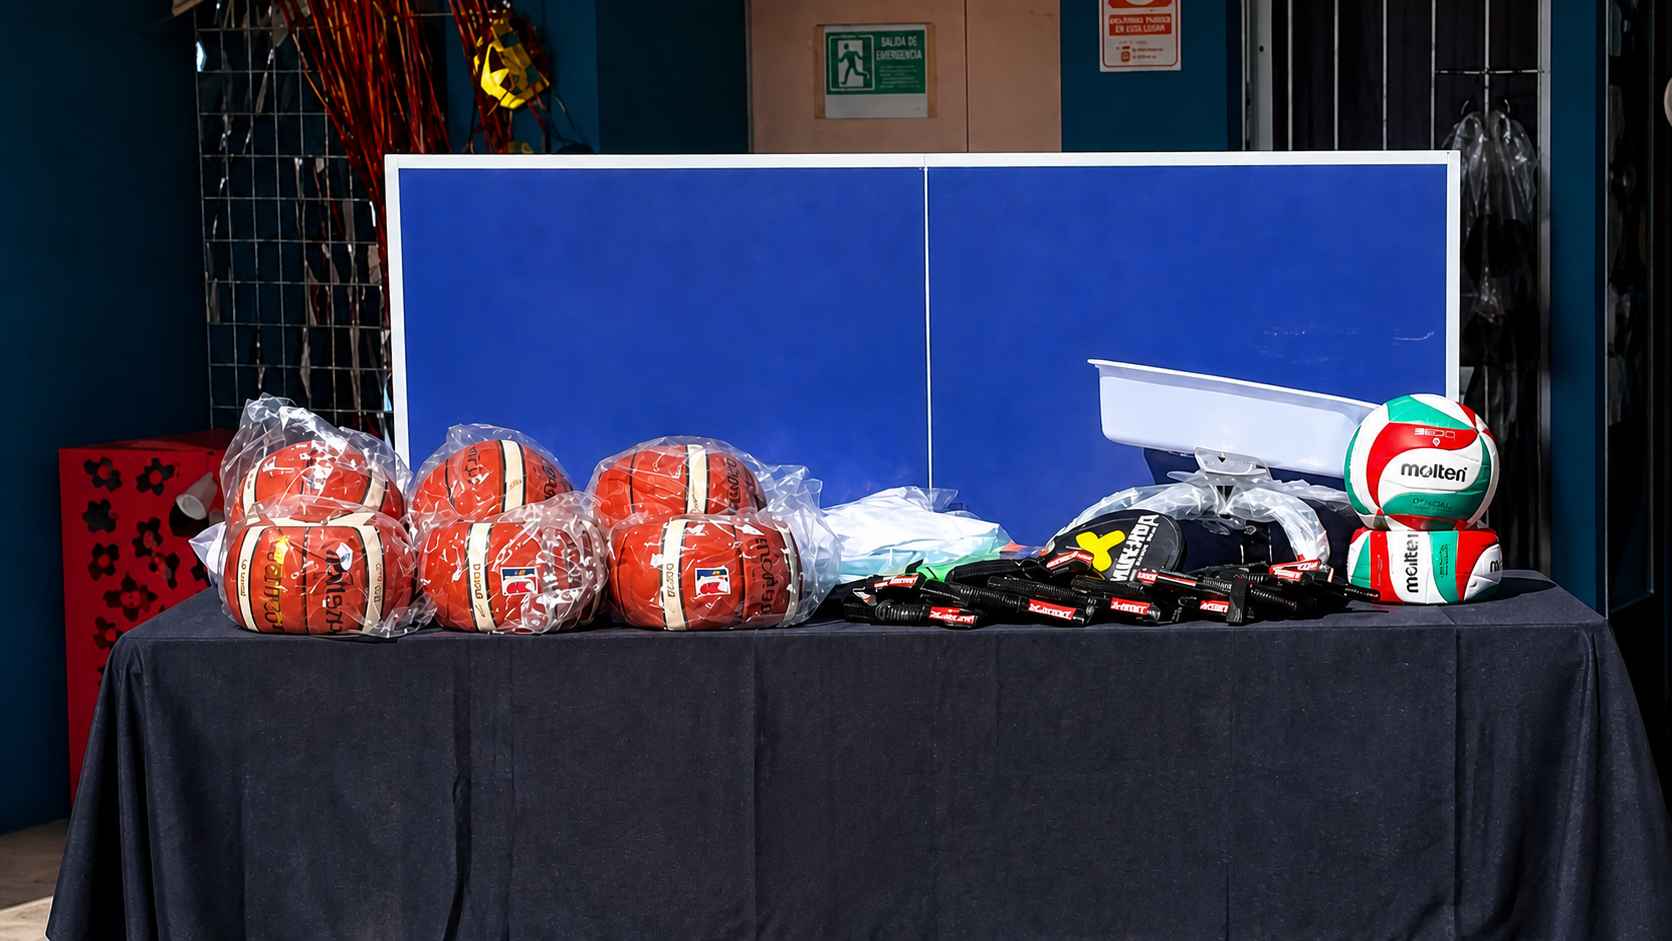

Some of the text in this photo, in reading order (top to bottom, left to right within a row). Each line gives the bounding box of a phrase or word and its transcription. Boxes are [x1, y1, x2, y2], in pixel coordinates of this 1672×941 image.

[881, 35, 918, 48] SALIDA DE
[1401, 463, 1466, 483] molten
